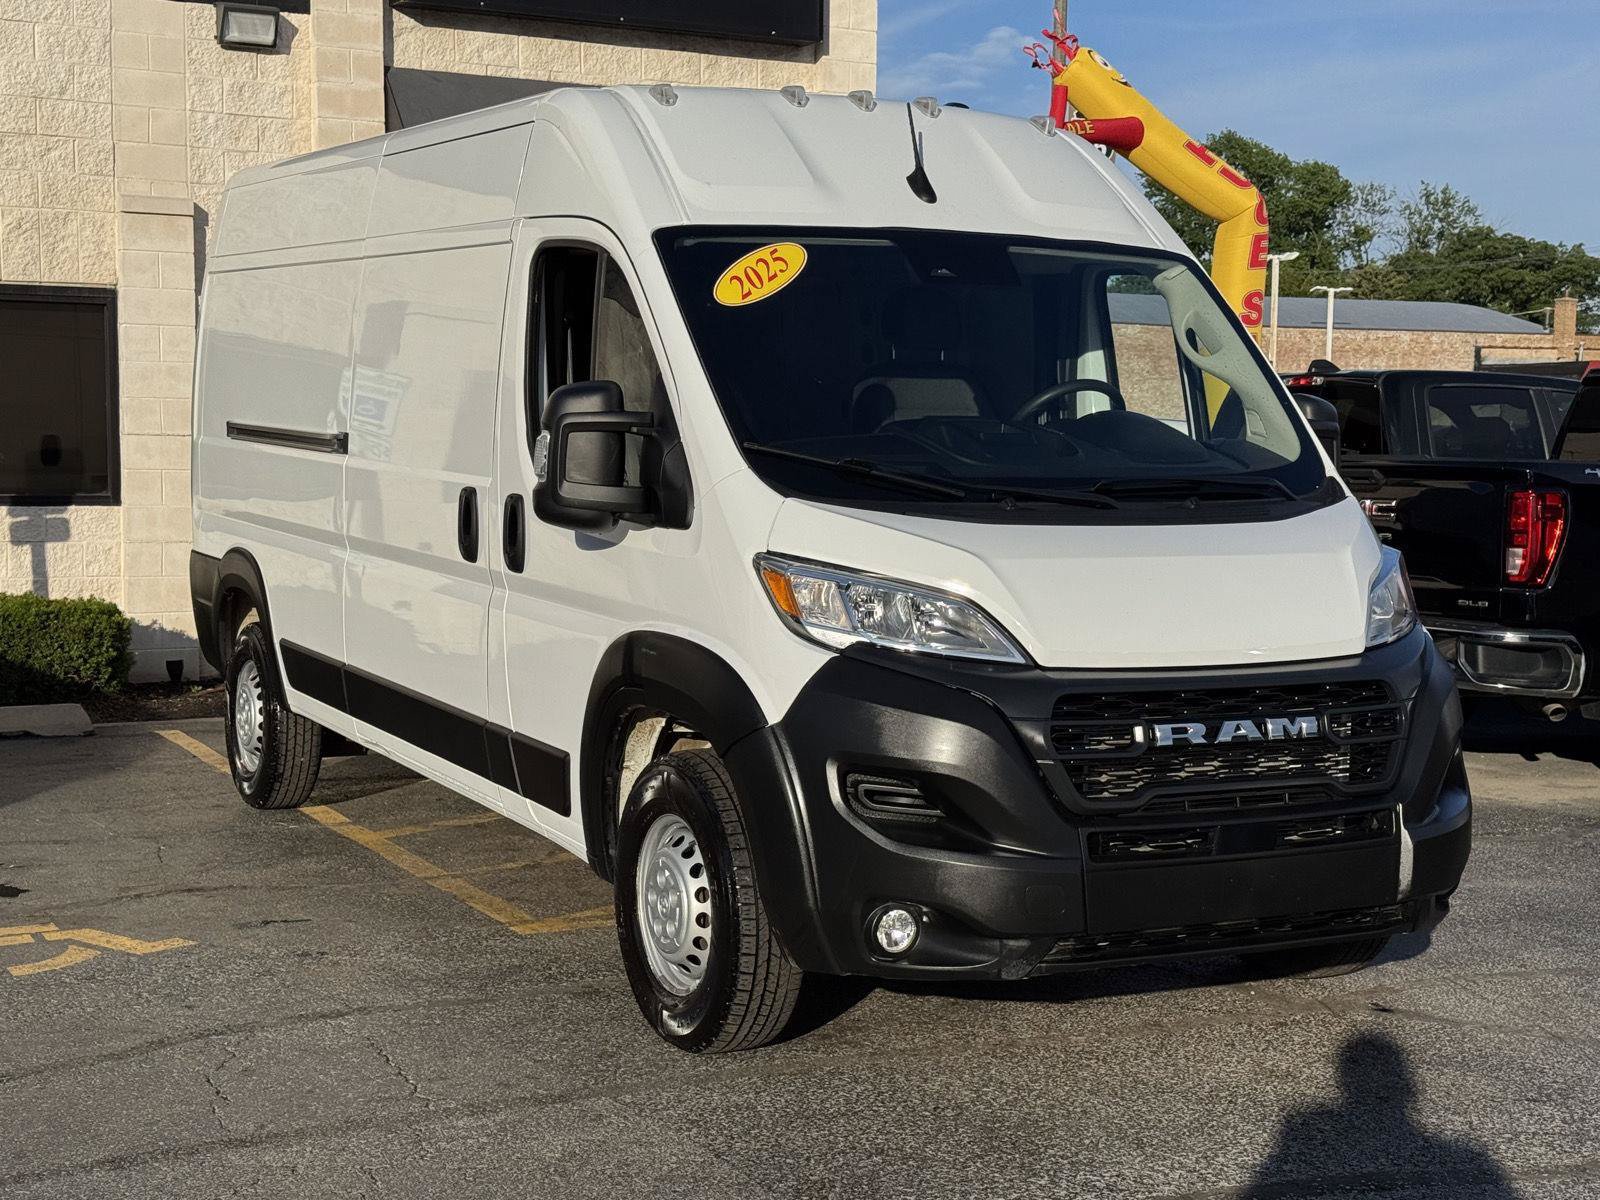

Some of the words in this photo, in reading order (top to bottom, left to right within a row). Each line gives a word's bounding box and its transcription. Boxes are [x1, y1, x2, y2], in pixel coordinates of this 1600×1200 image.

[1064, 120, 1096, 135] ALE
[729, 247, 789, 301] 2025
[1153, 715, 1319, 747] RAM
